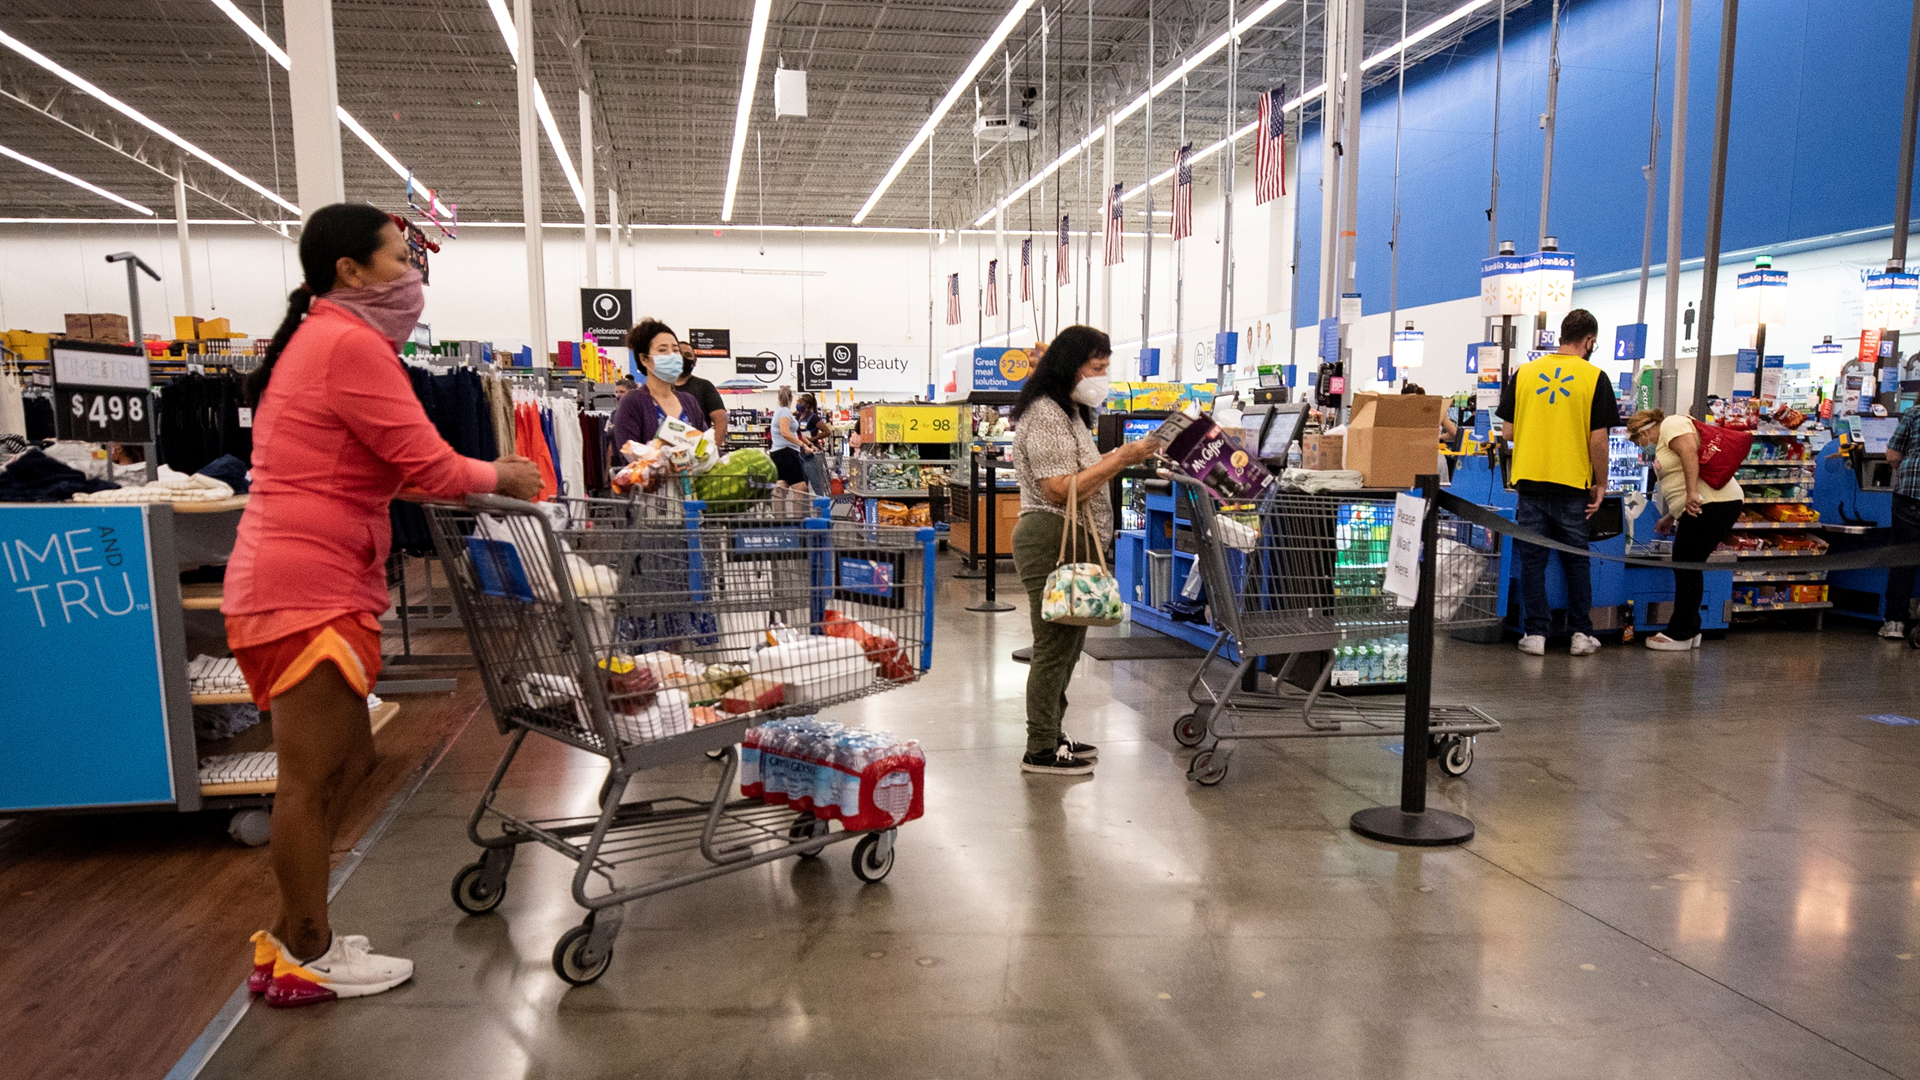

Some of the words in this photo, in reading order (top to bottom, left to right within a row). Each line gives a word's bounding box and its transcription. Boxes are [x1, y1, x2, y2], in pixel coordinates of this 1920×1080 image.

[588, 327, 628, 335] Celebrations
[1541, 331, 1555, 343] 50
[1617, 340, 1625, 357] 2
[1882, 343, 1892, 354] 51
[858, 355, 909, 373] Beauty
[975, 357, 998, 366] Great
[1468, 356, 1475, 370] 4
[975, 368, 994, 376] meal
[1378, 367, 1384, 380] 6
[975, 377, 1008, 386] solutions
[910, 419, 919, 431] 2
[1191, 458, 1208, 473] Mr.
[1201, 439, 1225, 461] Coffee
[1397, 508, 1416, 527] Please
[1396, 535, 1412, 552] Wait
[1, 527, 103, 583] IME
[97, 526, 124, 568] AND
[1395, 560, 1409, 578] Here
[16, 571, 135, 628] TRU
